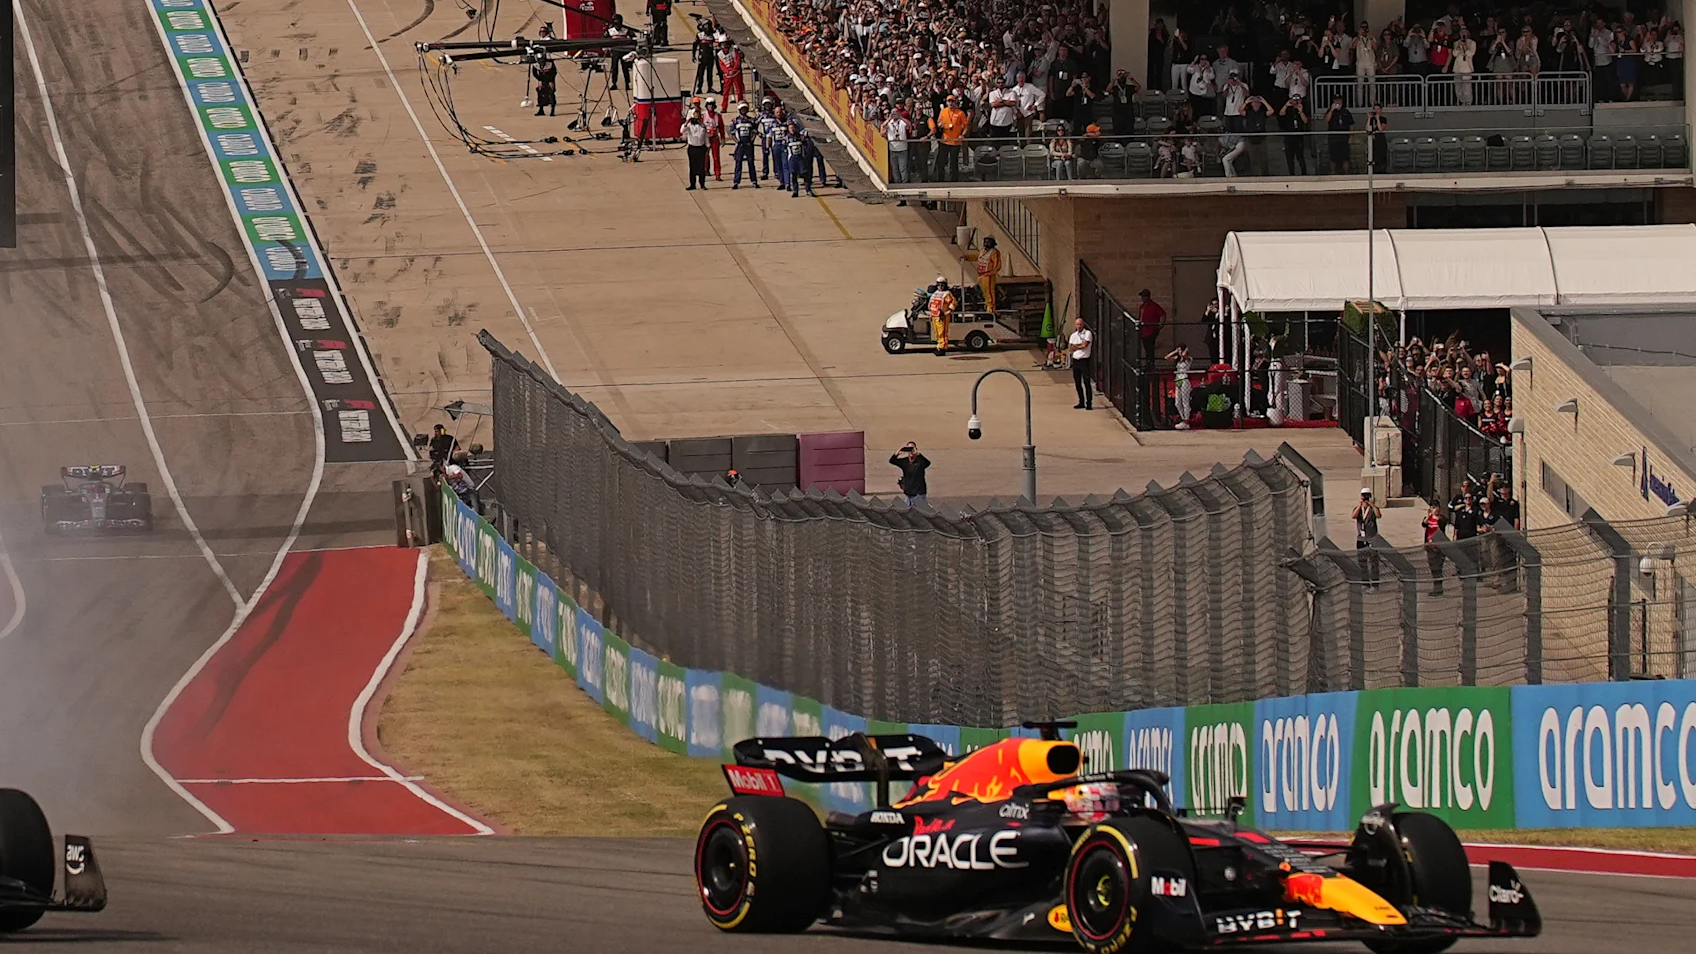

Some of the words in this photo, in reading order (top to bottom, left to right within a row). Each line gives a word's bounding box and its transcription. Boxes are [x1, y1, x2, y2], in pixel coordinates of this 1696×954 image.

[1369, 707, 1495, 811] aramco
[728, 770, 764, 790] Mobil
[870, 811, 905, 824] HONDA
[882, 830, 1030, 870] ORACLE
[1151, 876, 1186, 897] Mobil
[1216, 908, 1302, 934] BYBIT
